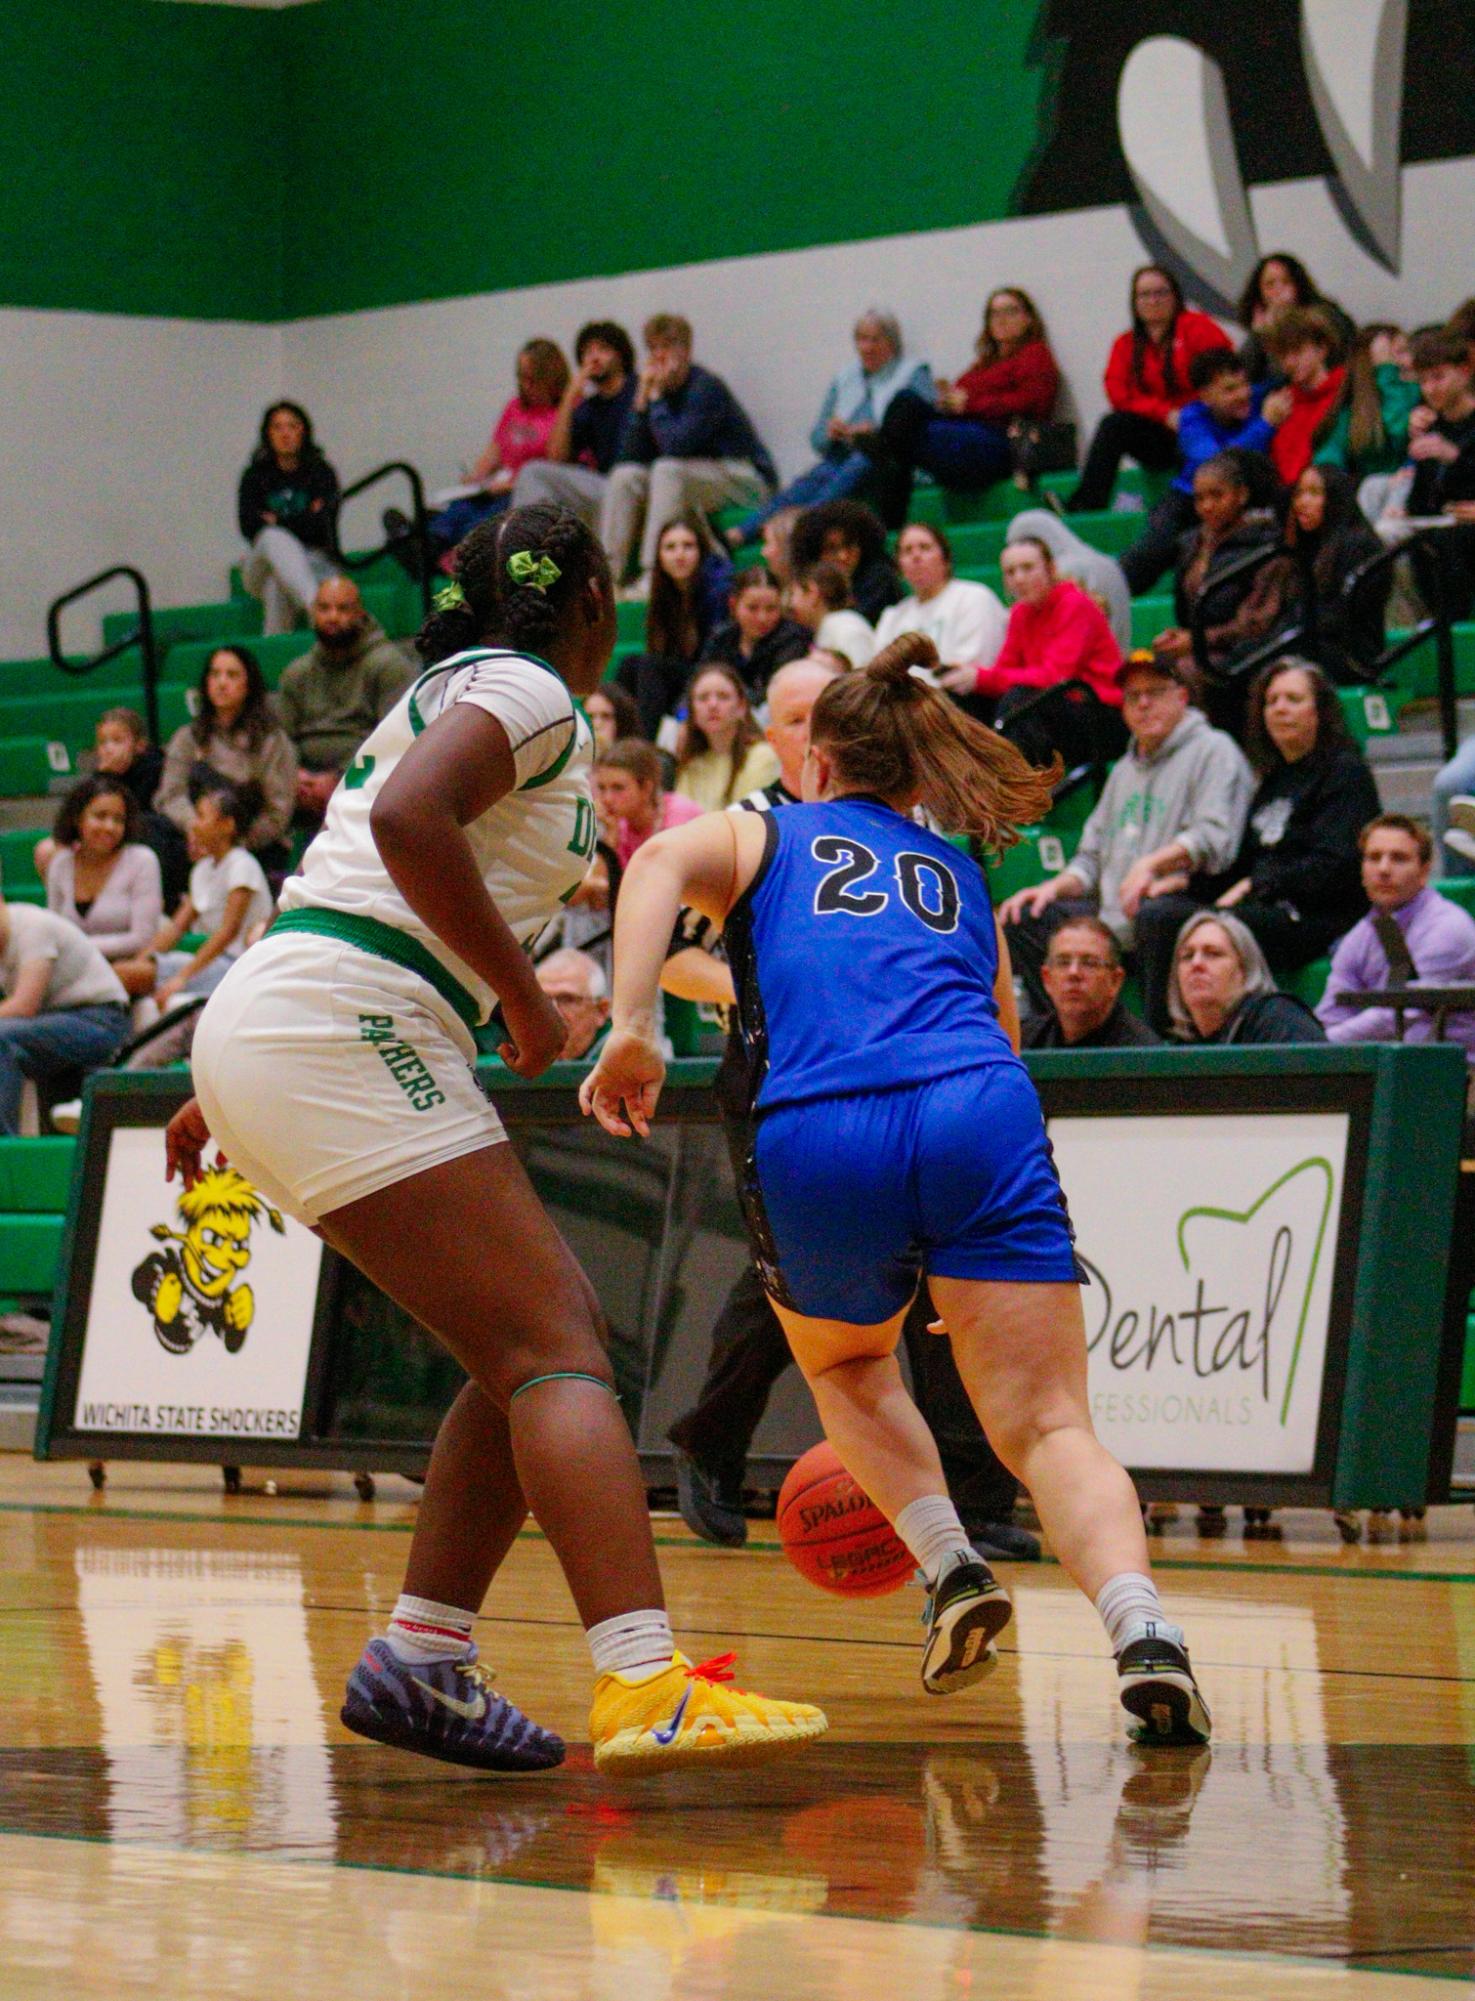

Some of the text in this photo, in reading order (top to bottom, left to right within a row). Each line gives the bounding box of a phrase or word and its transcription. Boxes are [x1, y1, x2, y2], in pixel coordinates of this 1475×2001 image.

[811, 835, 963, 934] 20
[83, 1403, 300, 1434] WICHITA STATE SHOCKERS
[1091, 1391, 1253, 1426] FESSIONALS
